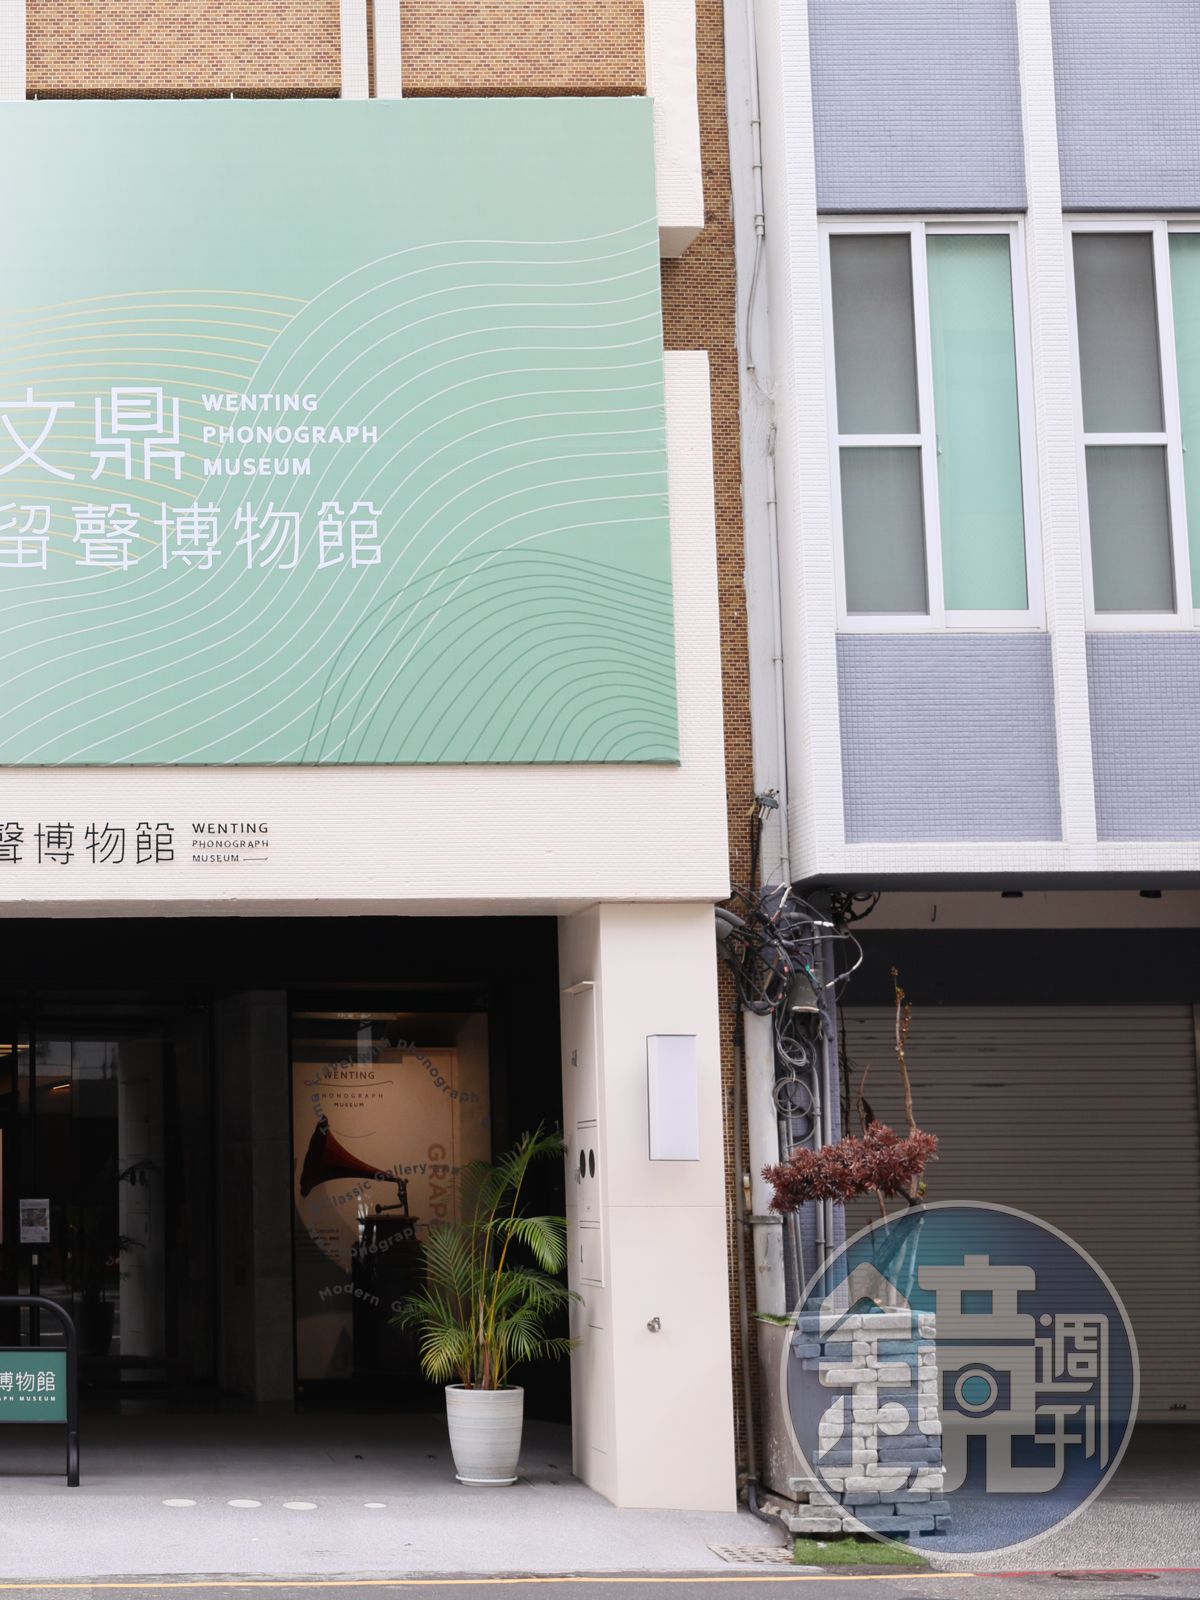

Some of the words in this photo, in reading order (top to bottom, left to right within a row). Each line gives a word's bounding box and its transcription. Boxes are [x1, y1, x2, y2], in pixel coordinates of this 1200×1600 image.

[201, 393, 318, 412] WENTING
[202, 425, 378, 444] PHONOGRAPH
[202, 457, 311, 476] MUSEUM
[191, 822, 268, 834] WENTING
[191, 839, 269, 849] PHONOGRAPH
[191, 854, 239, 863] MUSEUM
[322, 1071, 375, 1080] WENTING
[324, 1180, 373, 1207] lassic
[318, 1282, 382, 1307] Modern
